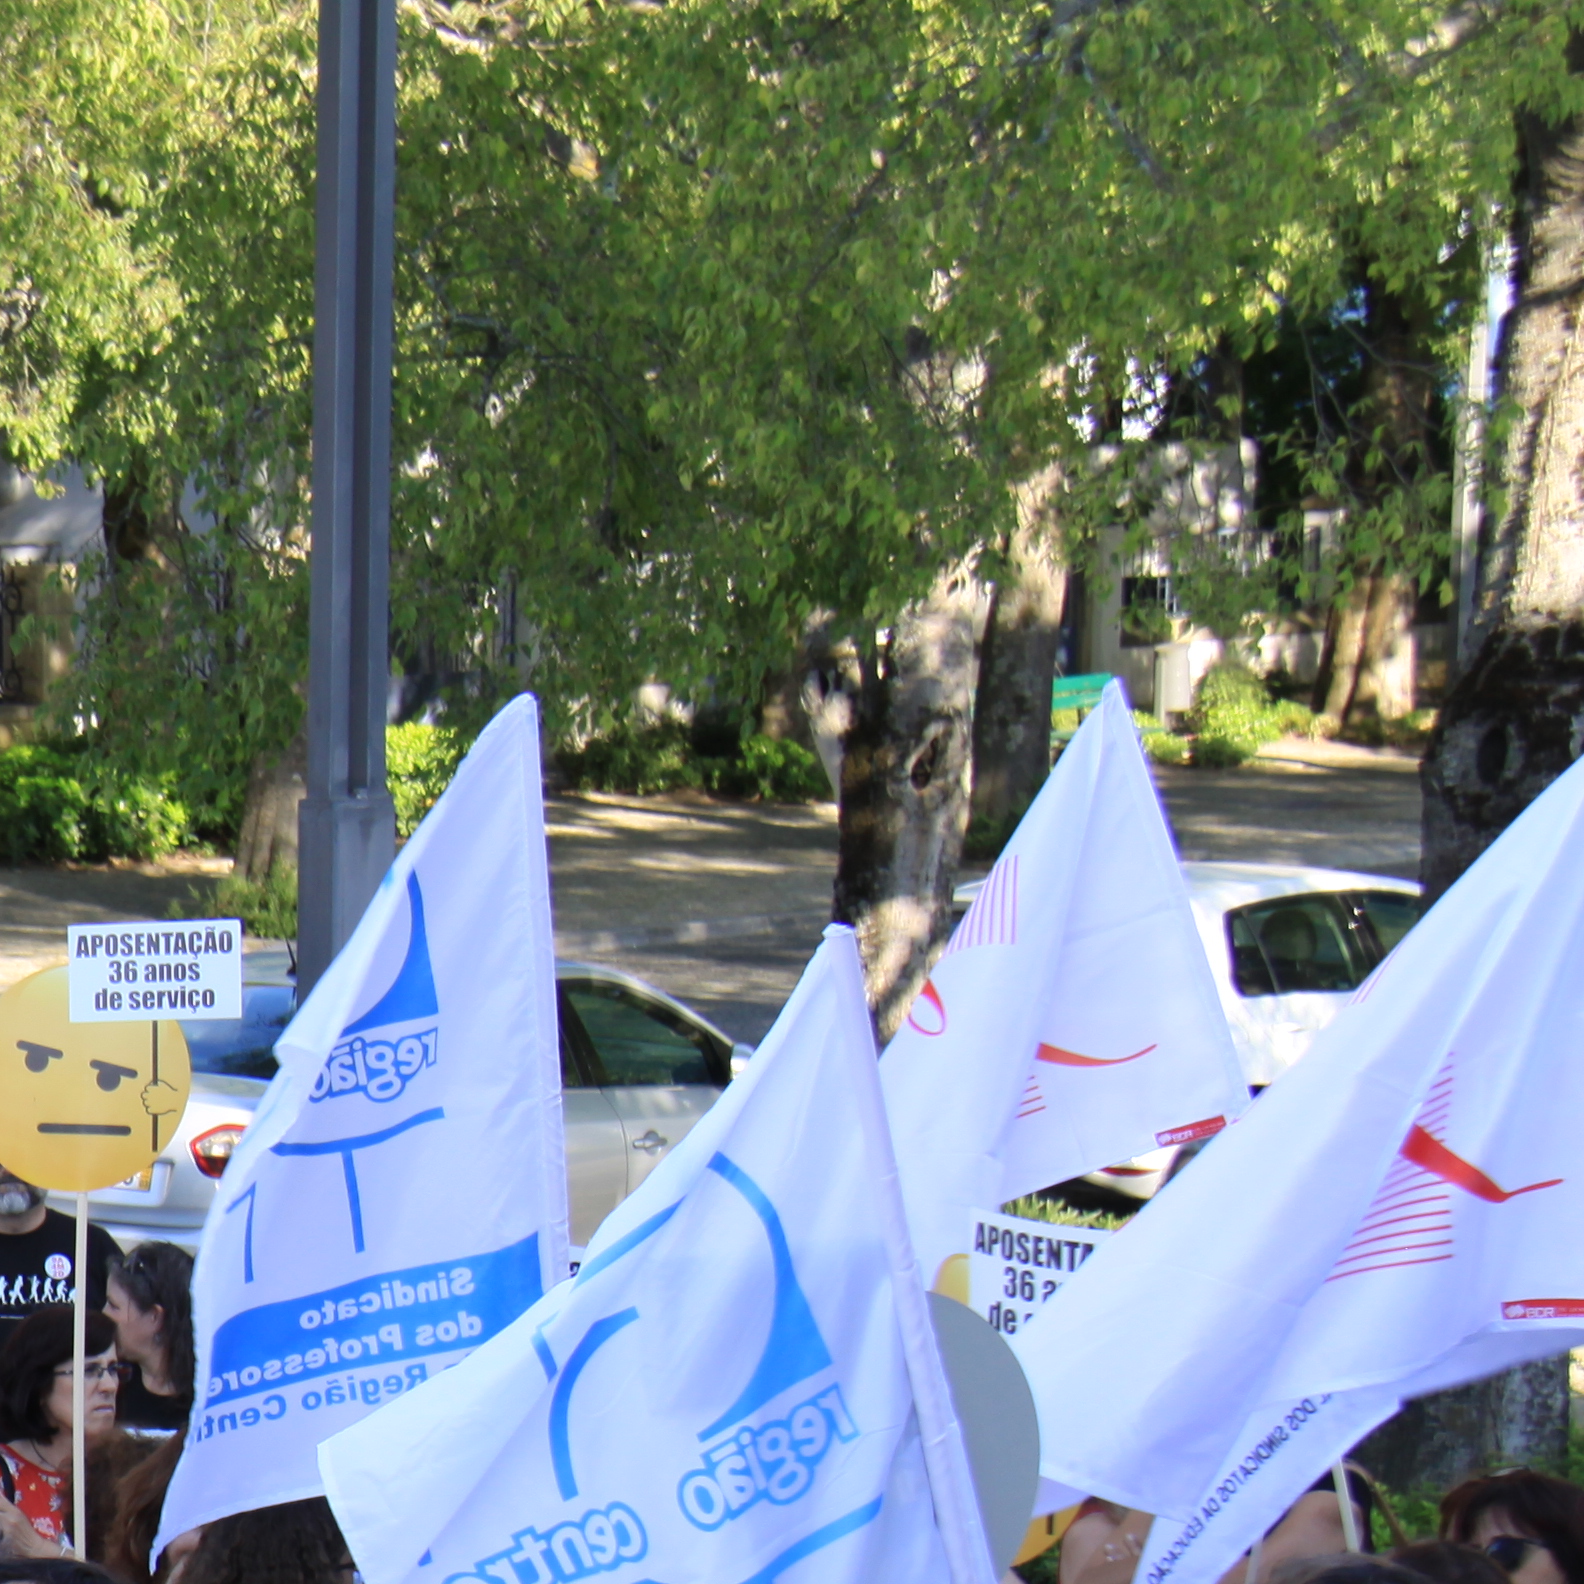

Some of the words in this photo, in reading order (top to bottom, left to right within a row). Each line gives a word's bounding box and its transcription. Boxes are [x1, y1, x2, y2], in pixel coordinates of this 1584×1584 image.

[76, 926, 233, 960] APOSENTAÇÃO
[108, 960, 138, 984] 36
[144, 962, 201, 983] anos
[94, 988, 122, 1011] de
[128, 985, 215, 1014] serviço
[1003, 1266, 1035, 1302] 36
[988, 1301, 1017, 1335] de
